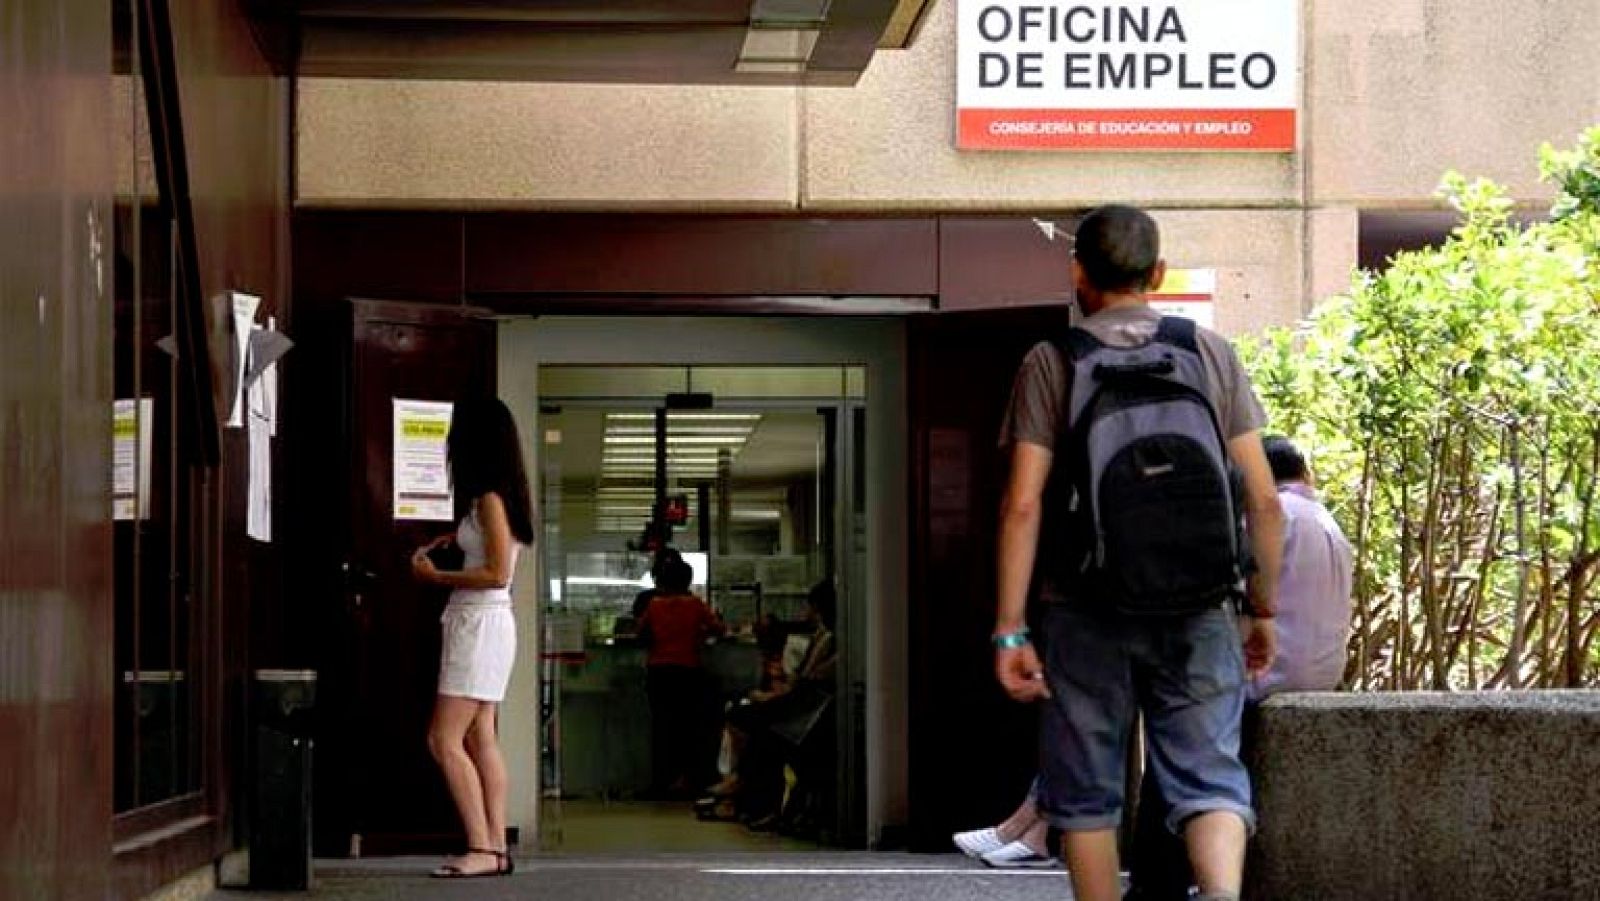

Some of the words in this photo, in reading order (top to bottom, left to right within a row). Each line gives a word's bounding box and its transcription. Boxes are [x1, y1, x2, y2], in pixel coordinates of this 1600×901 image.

[977, 5, 1188, 43] OFICINA
[978, 52, 1044, 89] DE
[1064, 52, 1277, 90] EMPLEO
[1078, 121, 1095, 135] DE
[1183, 121, 1192, 134] Y
[1194, 121, 1252, 135] EMPLEO
